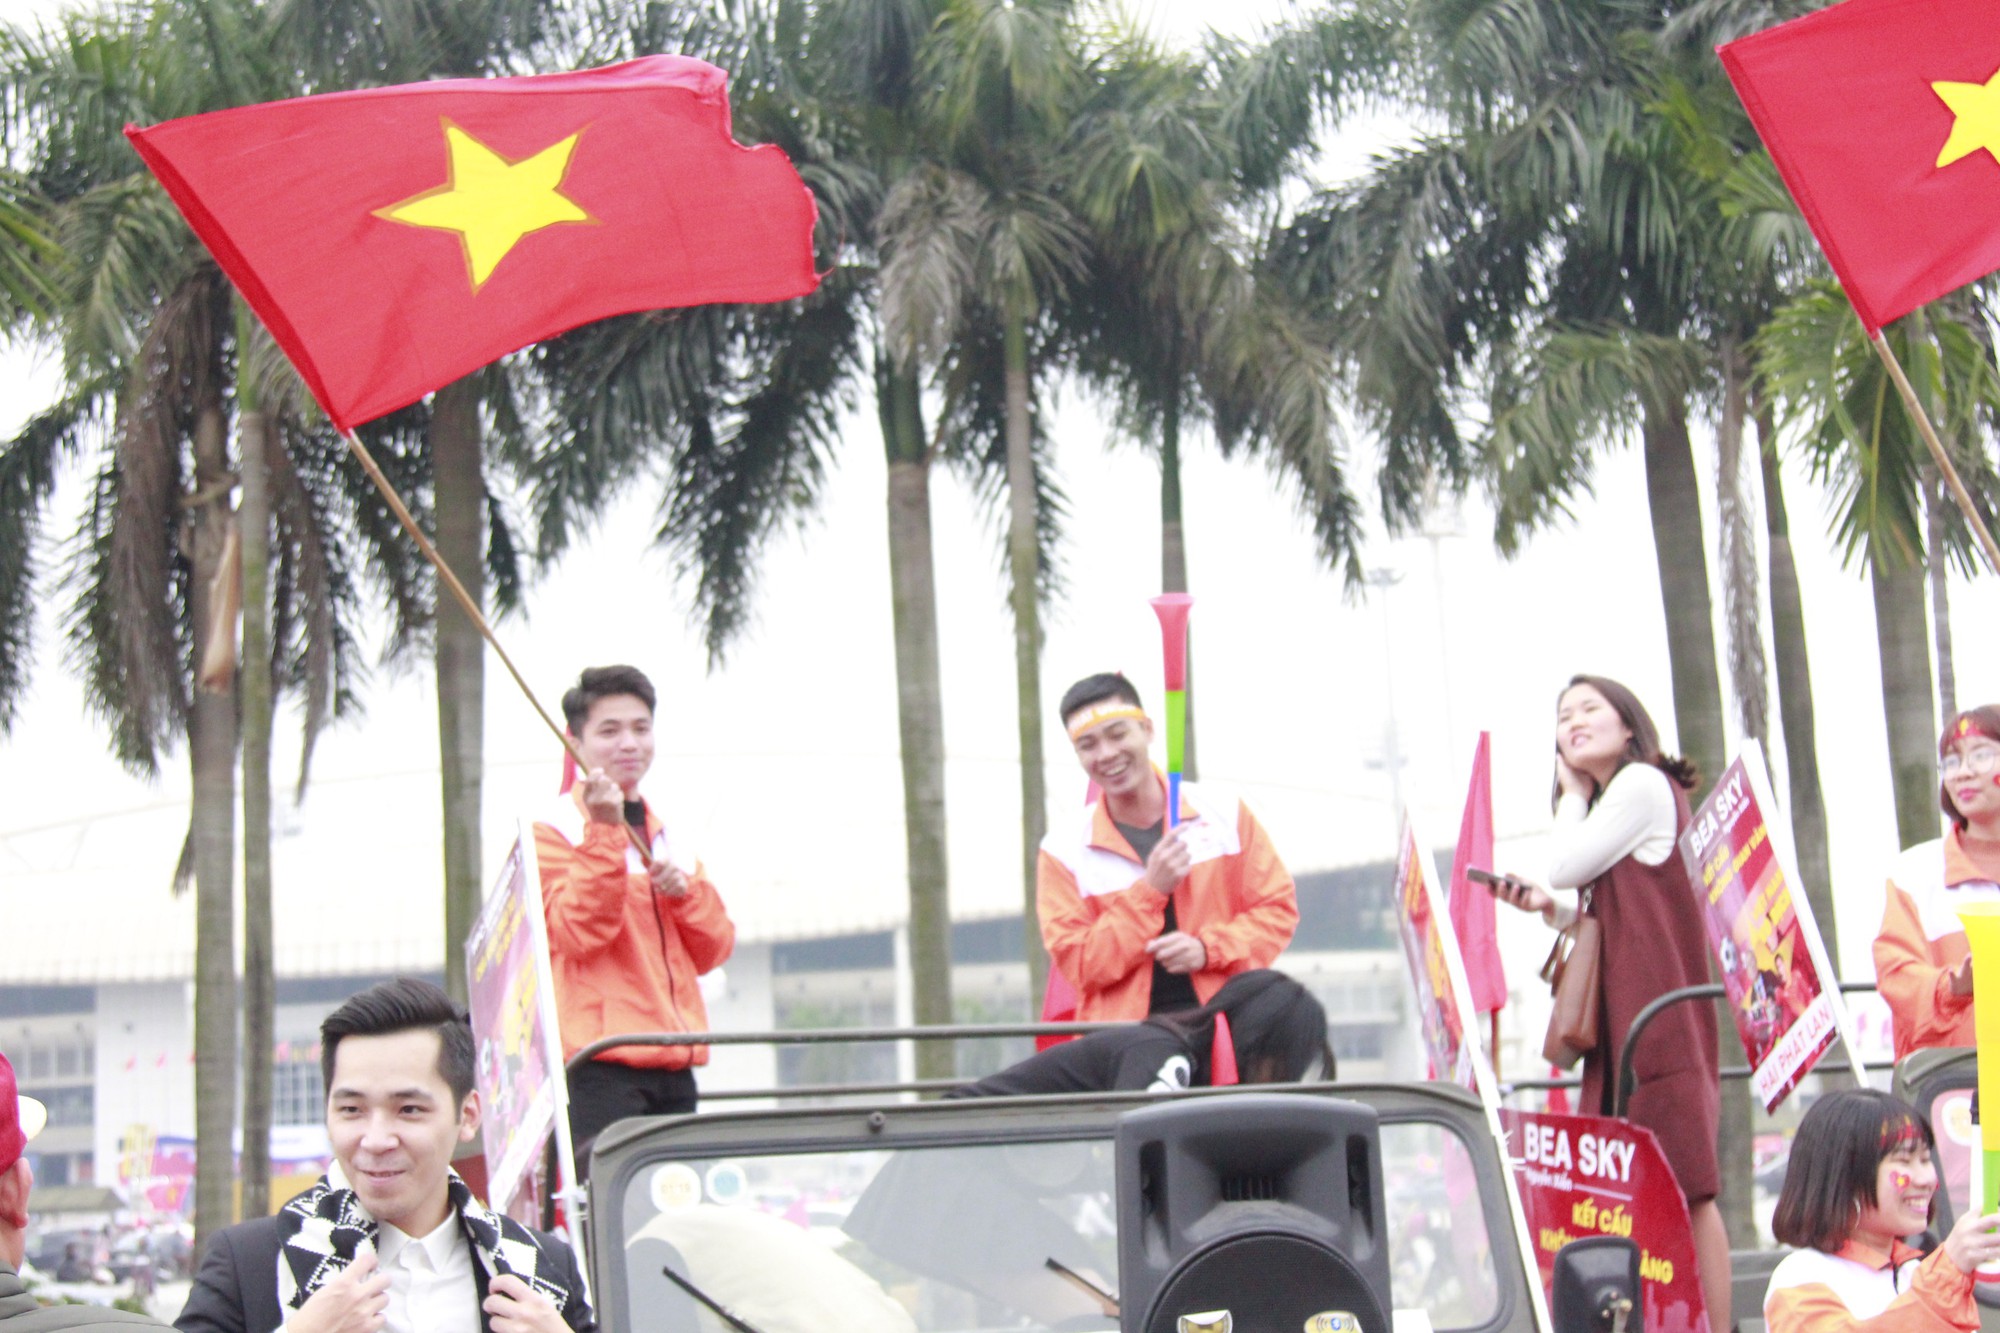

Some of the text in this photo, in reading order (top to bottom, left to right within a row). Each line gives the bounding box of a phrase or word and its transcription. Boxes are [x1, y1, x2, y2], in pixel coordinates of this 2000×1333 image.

[1690, 771, 1743, 858] BEA SKY
[1524, 1122, 1636, 1183] BEA SKY
[1571, 1197, 1633, 1239] KẾT CẤU
[1638, 1248, 1674, 1285] ÀNG
